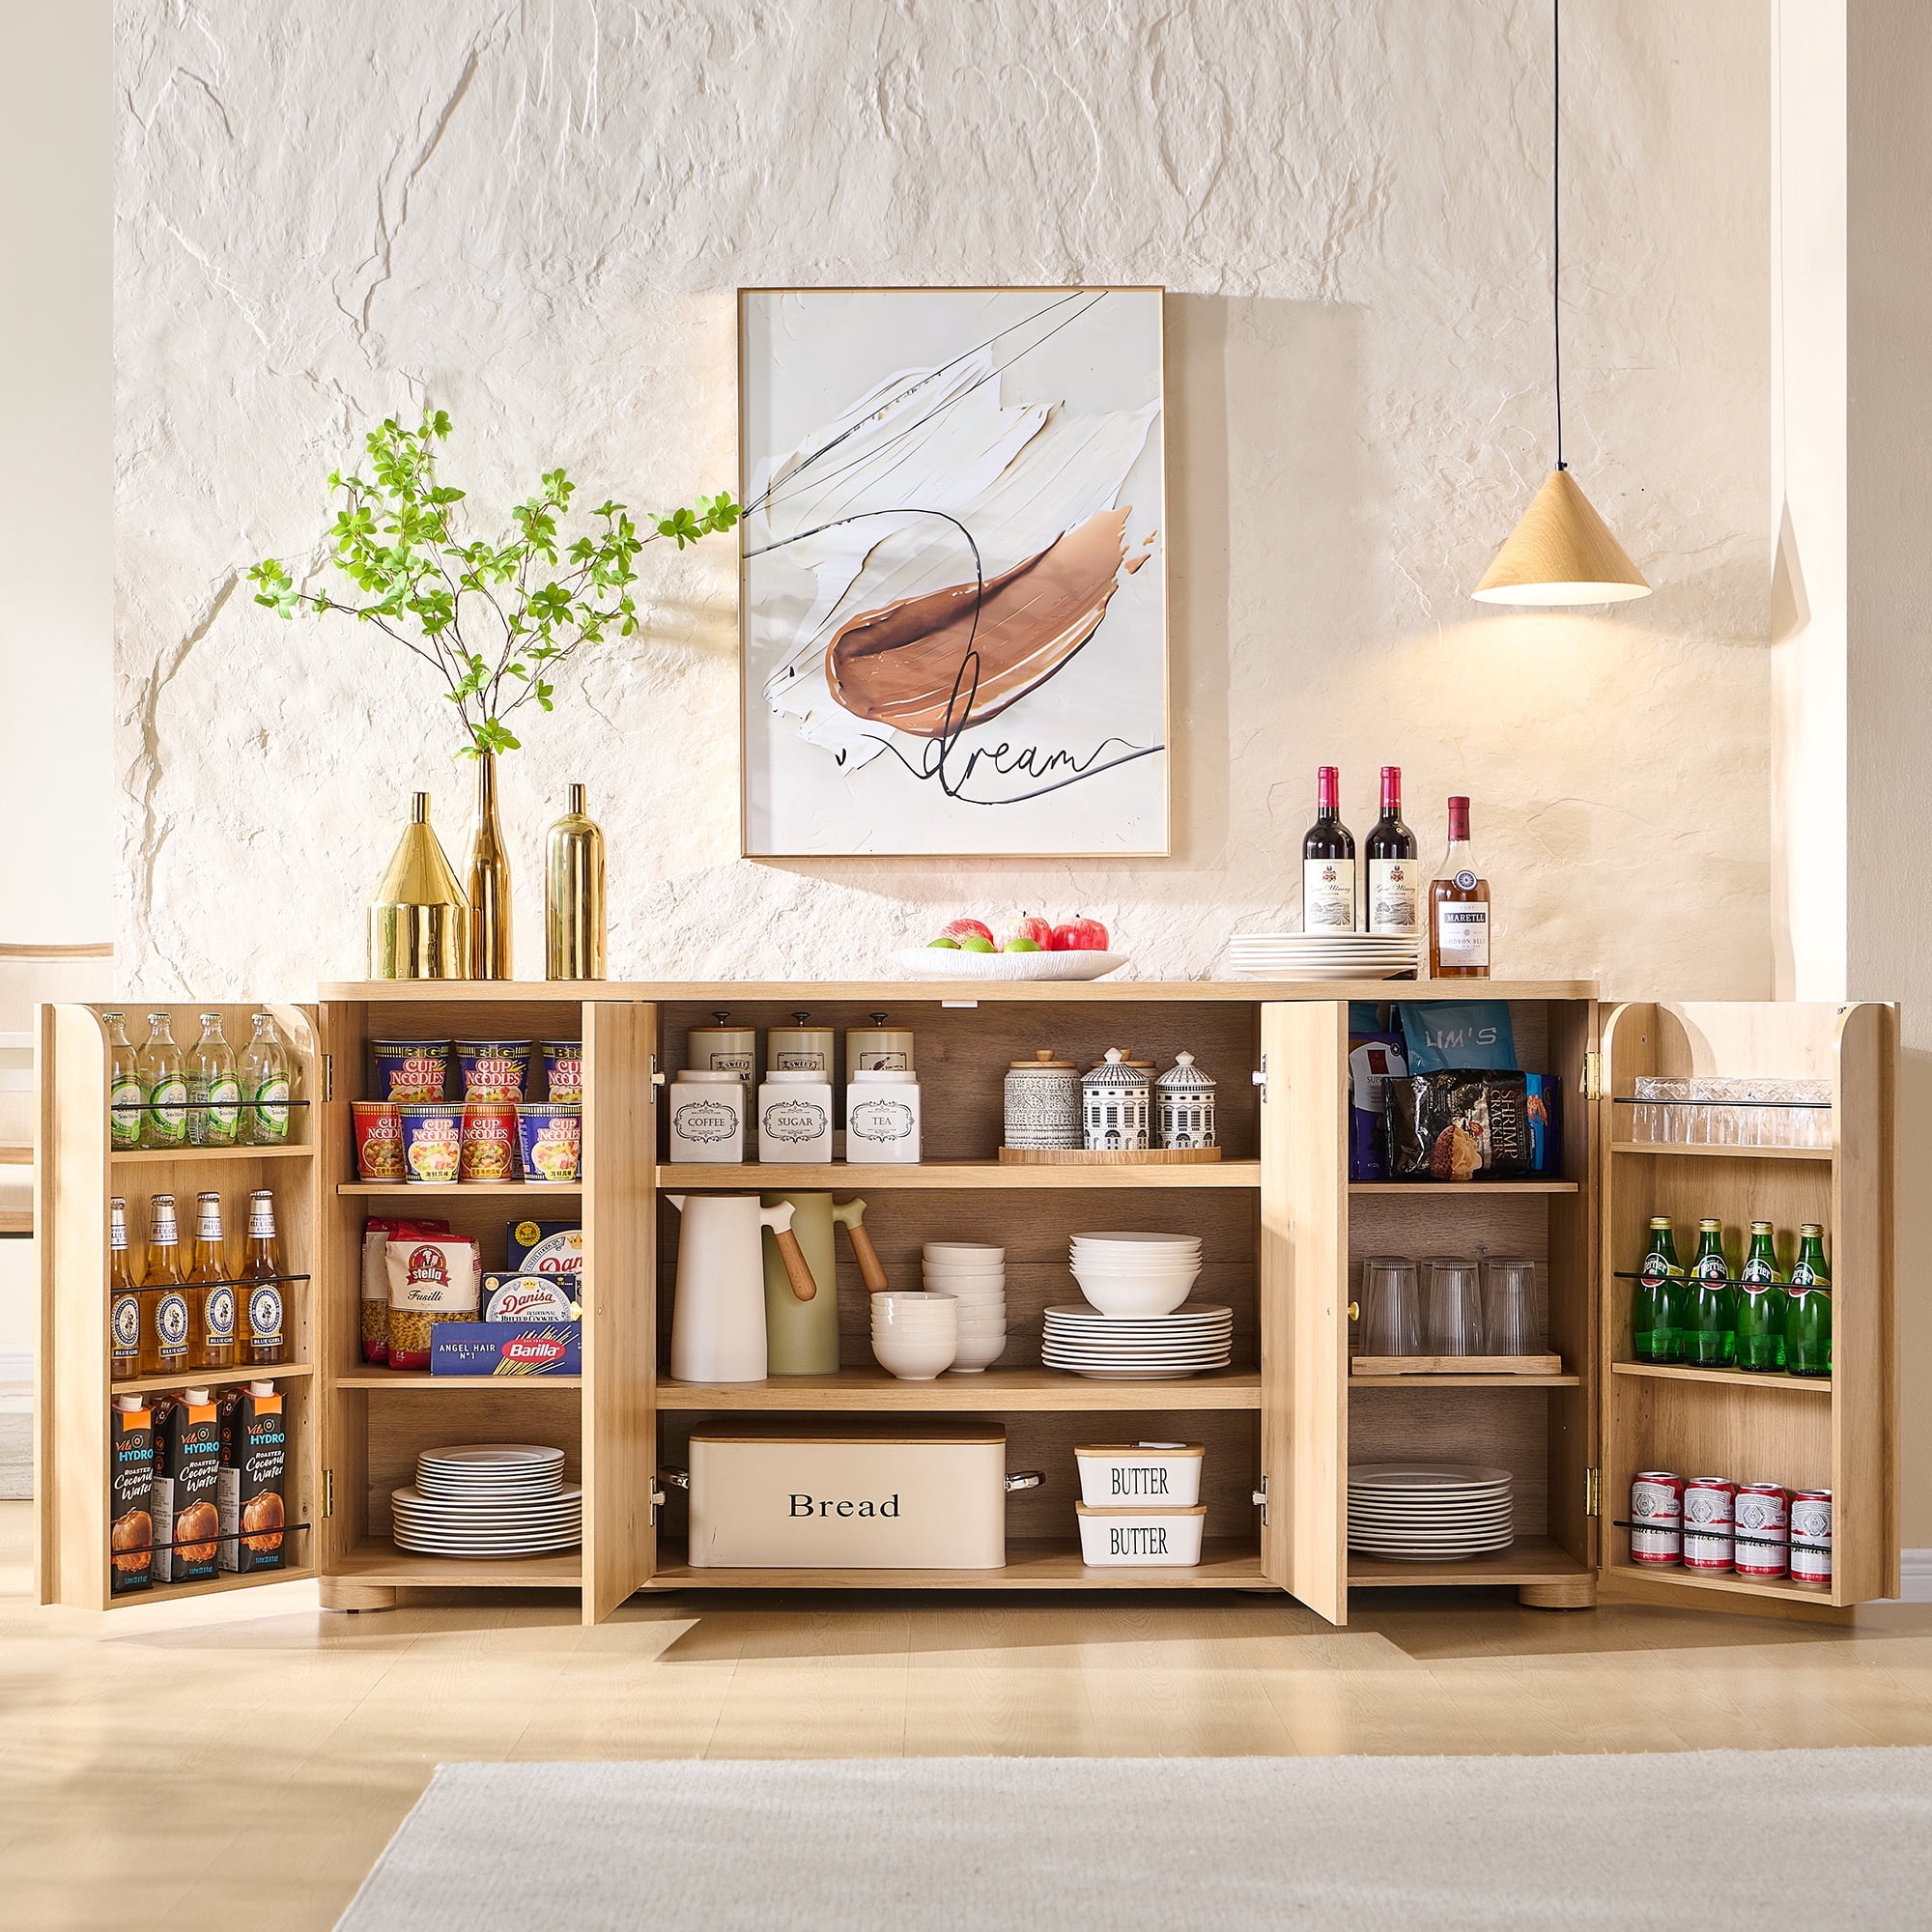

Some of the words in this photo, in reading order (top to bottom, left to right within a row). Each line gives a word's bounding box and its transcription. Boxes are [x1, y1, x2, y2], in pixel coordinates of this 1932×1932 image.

[898, 651, 1121, 798] dream
[1446, 914, 1485, 923] MARETLL
[1425, 1027, 1497, 1050] LIM'S
[402, 1047, 440, 1059] BIG
[474, 1047, 515, 1059] BIG
[404, 1060, 438, 1072] CUP
[477, 1060, 512, 1072] CUP
[556, 1060, 582, 1073] CU
[390, 1071, 444, 1086] NOODLES
[467, 1071, 521, 1086] NOODLES
[549, 1071, 582, 1086] NOOD
[378, 1118, 398, 1128] CU
[423, 1119, 452, 1130] CUP
[472, 1119, 501, 1129] CUP
[550, 1119, 577, 1129] CUP
[688, 1118, 725, 1126] COFFEE
[778, 1118, 813, 1126] SUGAR
[871, 1117, 892, 1125] TEA
[1490, 1090, 1504, 1159] CRACKERS
[1501, 1090, 1519, 1159] SHRIMP
[414, 1129, 459, 1141] NOODLES
[464, 1128, 508, 1140] NOODLES
[412, 1268, 442, 1280] stella
[408, 1290, 443, 1301] Fusilli
[499, 1289, 555, 1315] Danisa
[509, 1344, 554, 1357] Barilla
[250, 1433, 285, 1445] HYDRO
[185, 1441, 219, 1454] HYDRO
[119, 1448, 154, 1462] HYDRO
[255, 1450, 281, 1459] ROASTED
[189, 1460, 216, 1468] ROASTED
[246, 1452, 285, 1472] Coconut
[124, 1467, 151, 1476] ROASTED
[179, 1461, 219, 1482] Coconut
[253, 1466, 283, 1482] Water
[114, 1468, 153, 1490] Coconut
[186, 1475, 218, 1492] Water
[1111, 1467, 1170, 1494] BUTTER
[122, 1483, 153, 1500] Water
[788, 1493, 901, 1518] Bread
[1110, 1527, 1169, 1555] BUTTER
